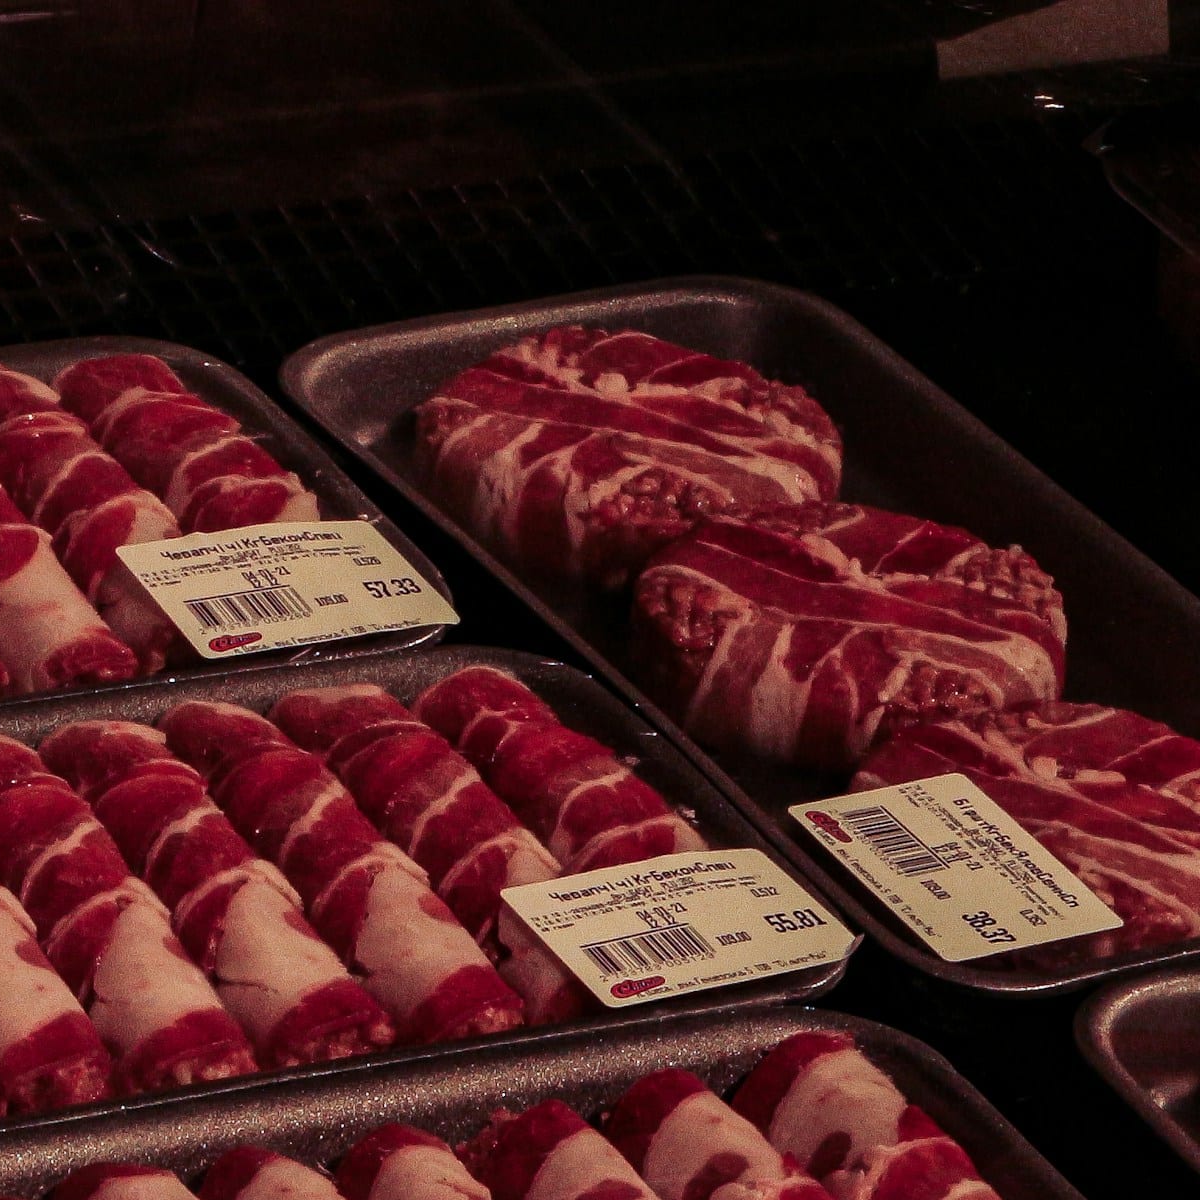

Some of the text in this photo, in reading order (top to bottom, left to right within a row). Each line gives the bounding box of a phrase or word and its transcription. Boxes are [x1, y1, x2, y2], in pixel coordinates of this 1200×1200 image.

[362, 576, 422, 598] 57.33
[636, 902, 688, 921] 04-01-21
[763, 907, 827, 933] 55.81
[962, 911, 1017, 945] 38.37
